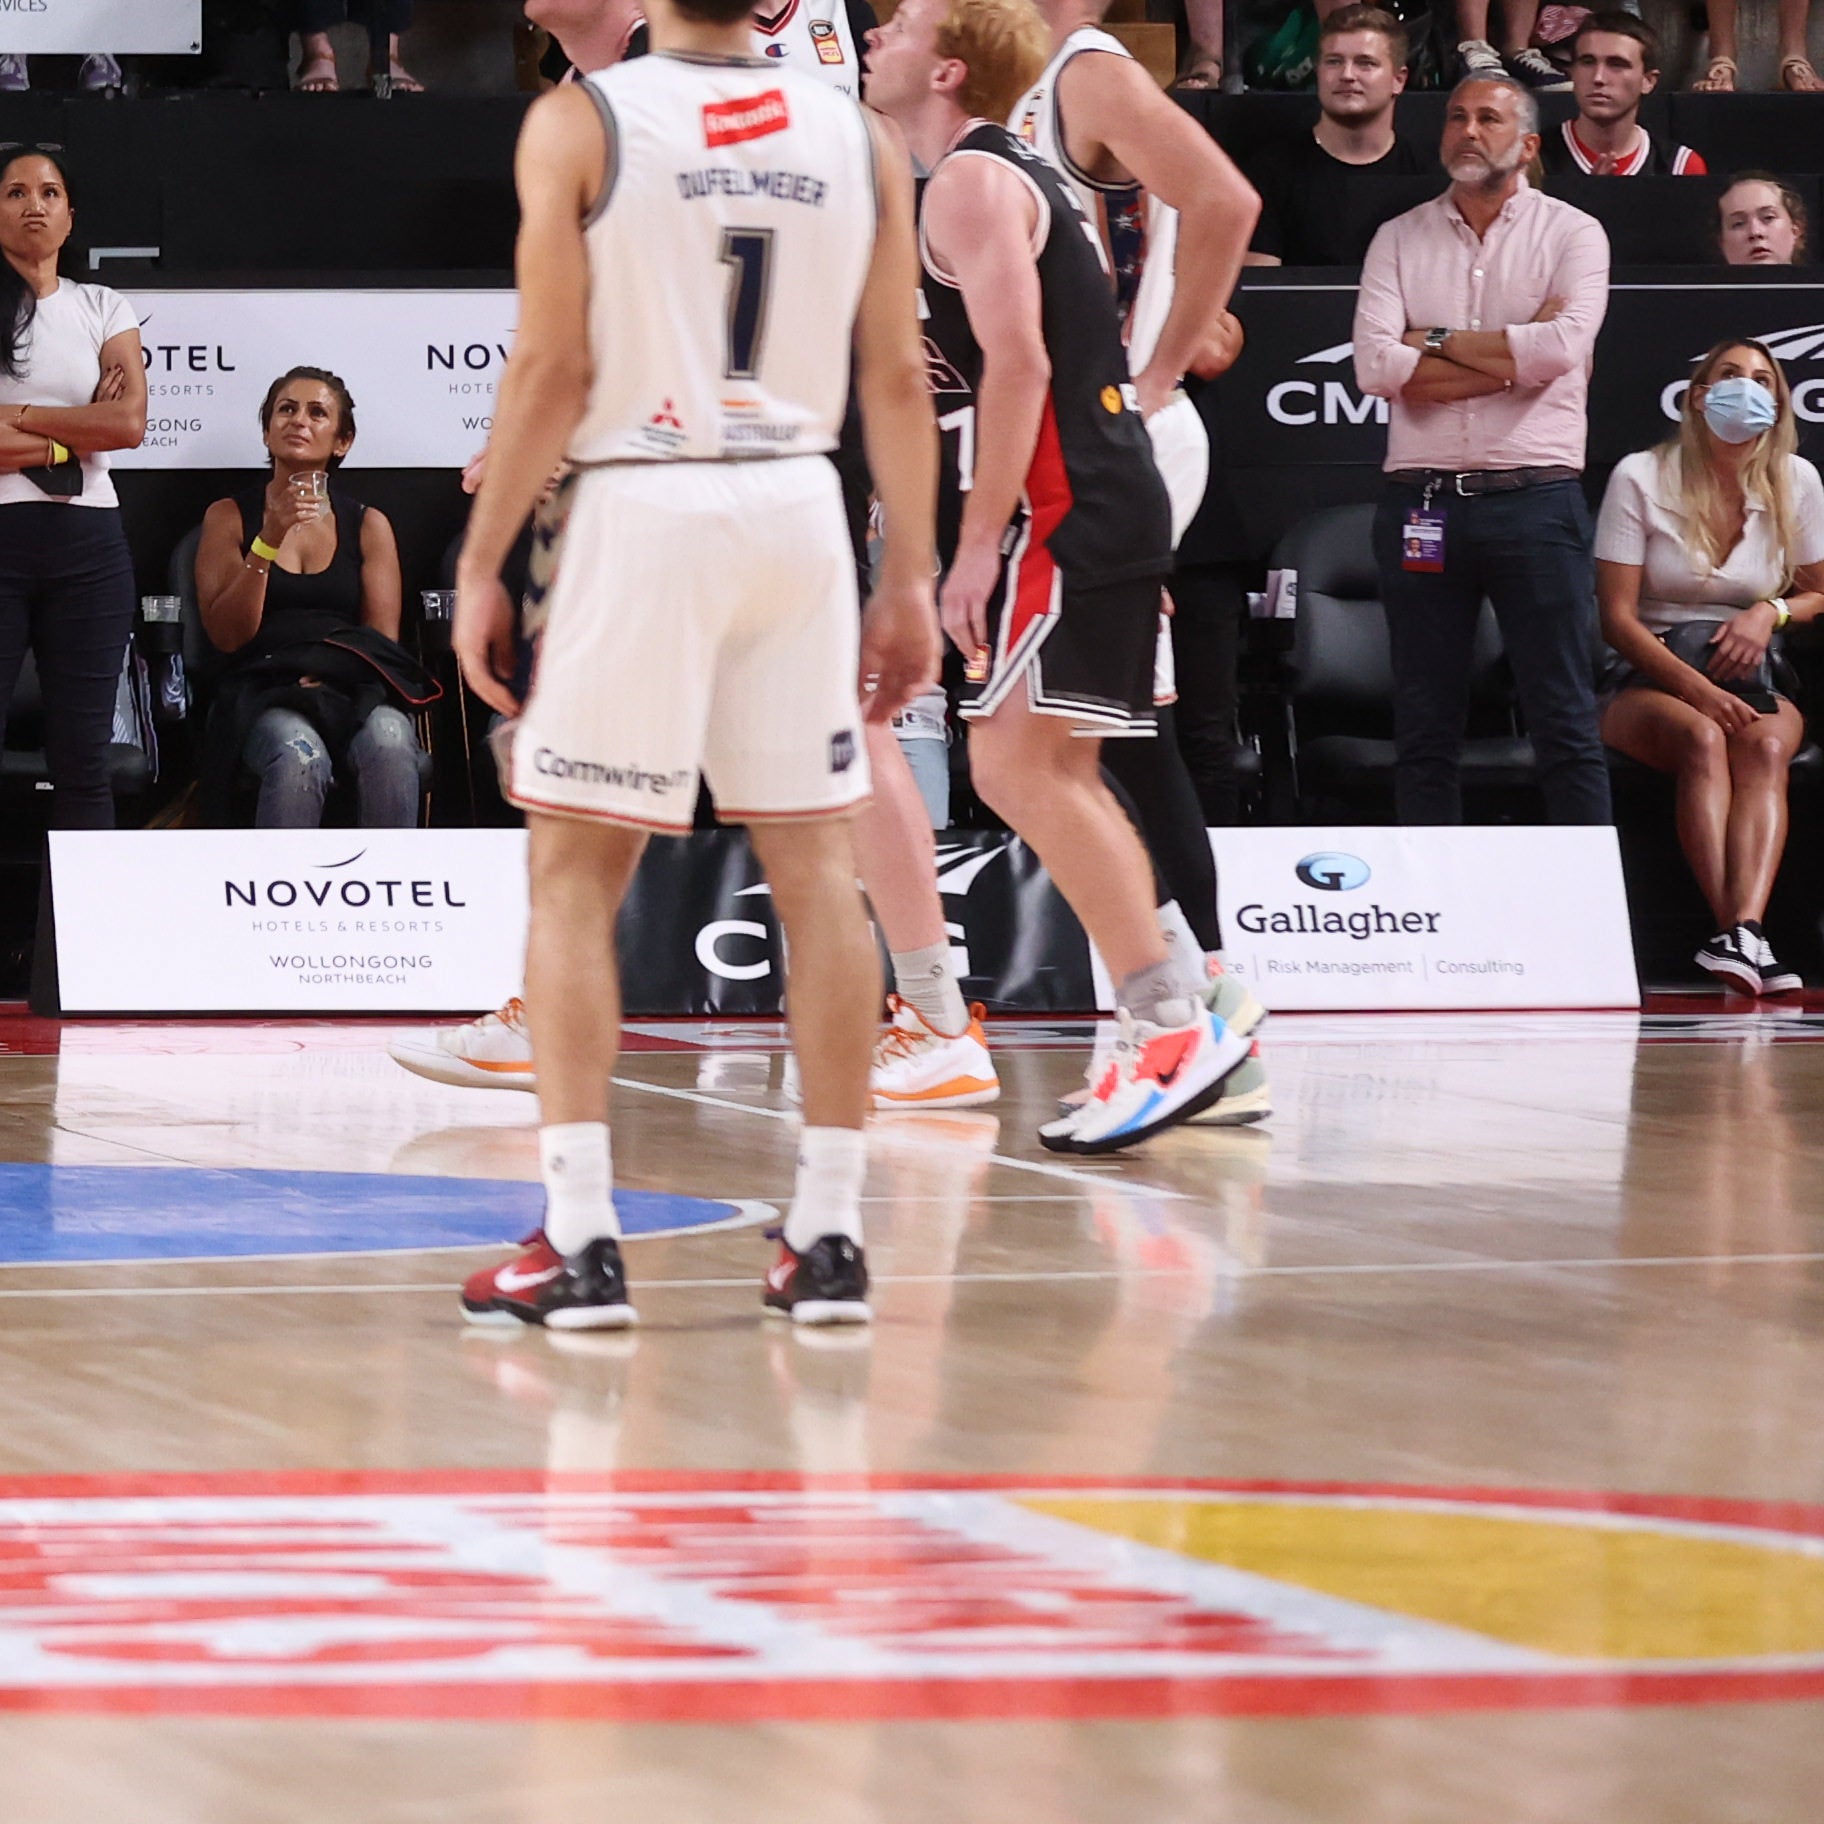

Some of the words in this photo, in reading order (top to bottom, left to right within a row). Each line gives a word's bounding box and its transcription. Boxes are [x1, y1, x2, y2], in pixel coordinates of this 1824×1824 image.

[717, 226, 778, 380] 1
[149, 384, 214, 396] ESORTS
[449, 383, 494, 394] HOTE
[224, 880, 466, 908] NOVOTEL
[252, 920, 329, 932] HOTELS
[337, 920, 347, 932] &
[355, 920, 444, 932] RESORTS
[1236, 904, 1442, 940] Gallagher
[269, 955, 433, 969] WOLLONGONG
[1267, 959, 1302, 975] Risk
[1306, 959, 1414, 976] Management
[1435, 959, 1525, 976] Consulting
[298, 973, 406, 984] NORTHBEACH
